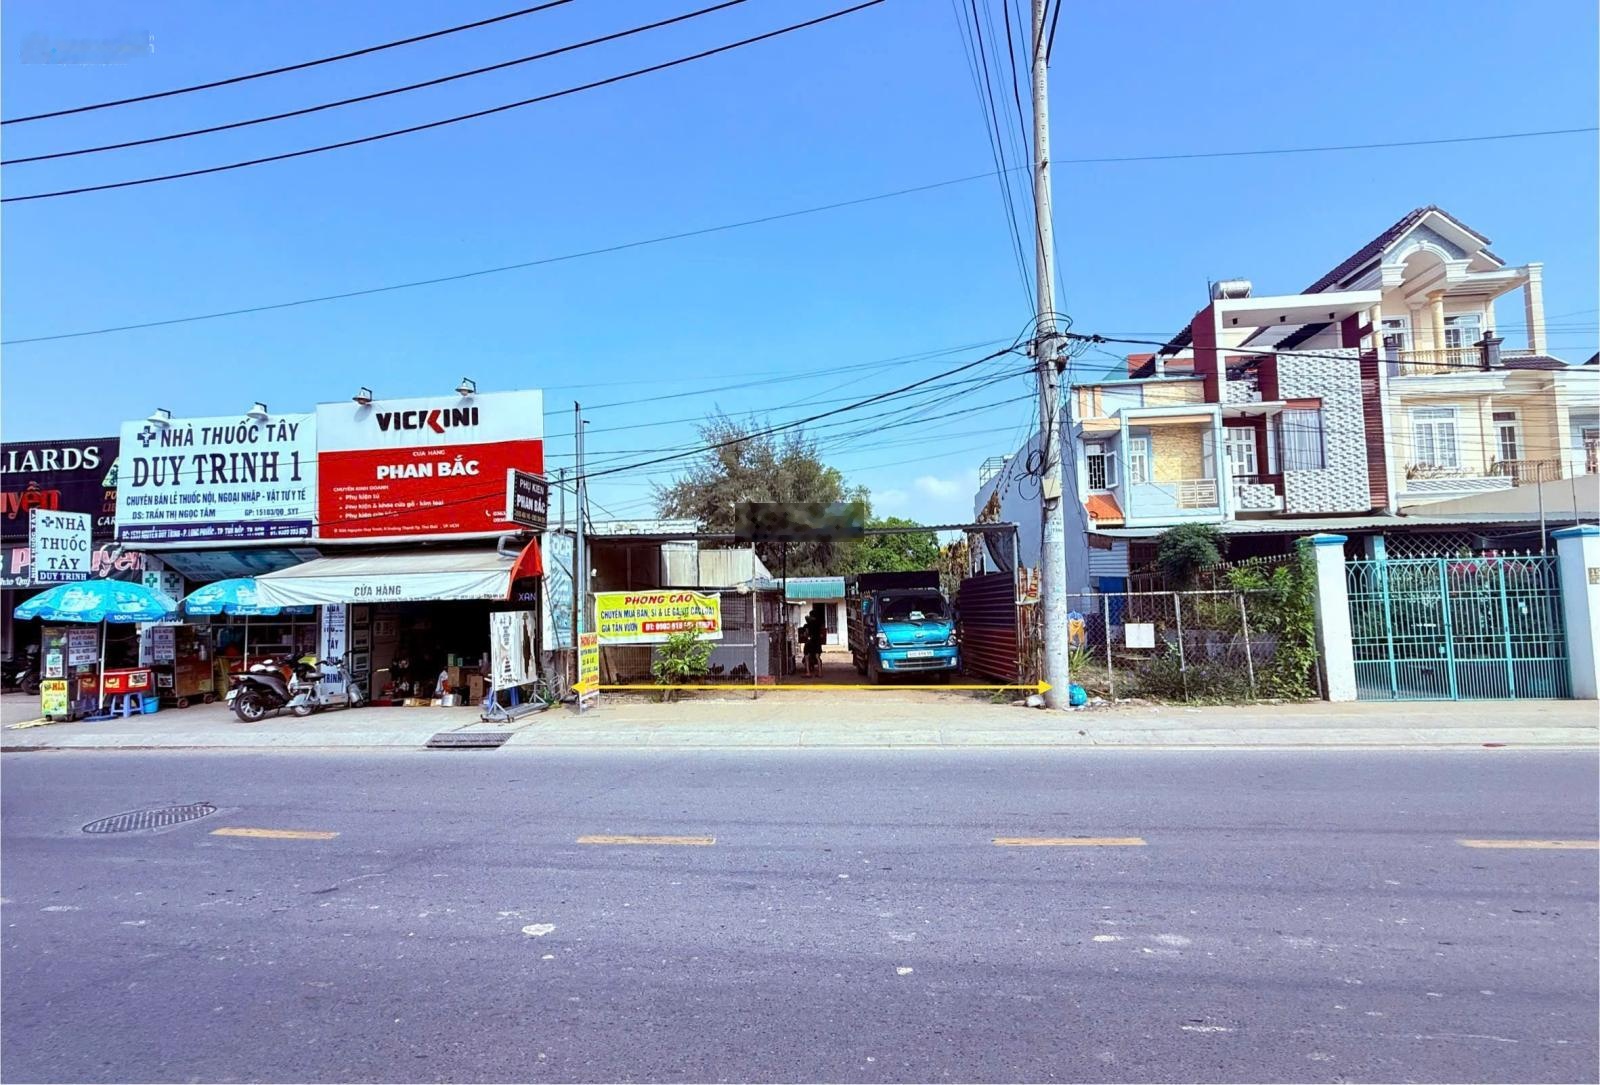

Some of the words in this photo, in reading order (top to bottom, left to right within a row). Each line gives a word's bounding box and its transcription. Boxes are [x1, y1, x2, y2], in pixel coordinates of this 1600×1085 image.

[376, 407, 479, 433] VICKINI
[161, 423, 194, 447] NHÀ
[202, 418, 259, 445] THUỐC
[266, 419, 299, 442] TÂY
[132, 455, 185, 487] DUY
[192, 451, 279, 484] TRINH
[291, 451, 302, 481] 1
[377, 463, 433, 480] PHAN
[437, 455, 480, 477] BẮC
[516, 494, 533, 511] PHAN
[55, 516, 86, 531] NHÀ
[41, 534, 87, 551] THUỐC
[48, 555, 80, 570] TÂY
[40, 572, 58, 580] DUY
[60, 573, 87, 581] TRINH
[624, 596, 665, 605] PHONG
